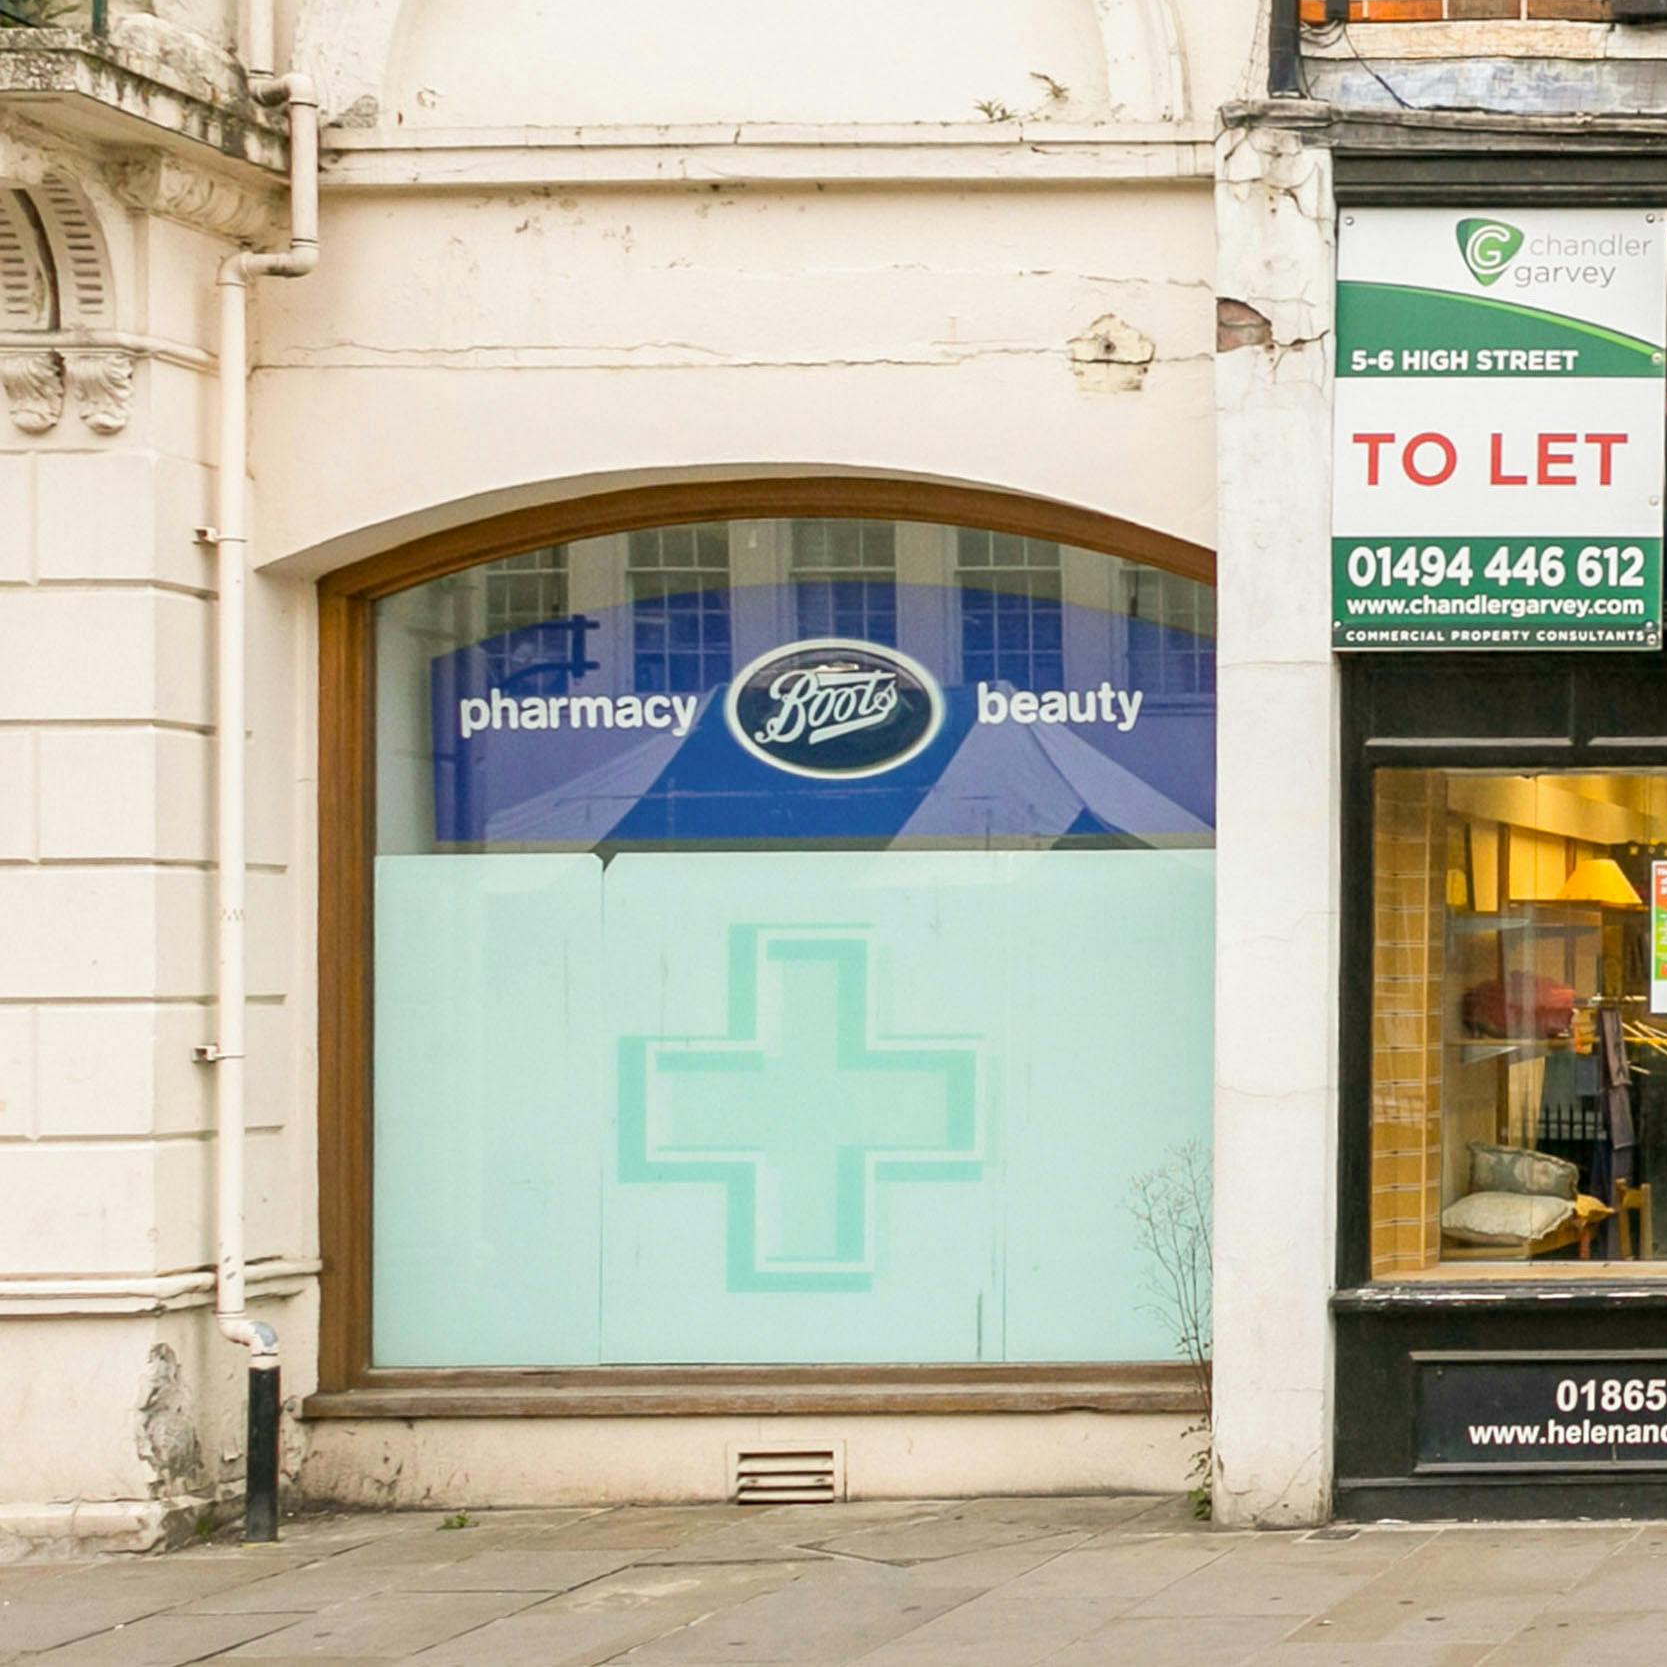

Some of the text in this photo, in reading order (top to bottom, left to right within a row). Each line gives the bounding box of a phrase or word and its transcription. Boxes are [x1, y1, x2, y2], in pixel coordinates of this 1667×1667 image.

[1530, 233, 1653, 256] chandler
[1515, 266, 1616, 288] garvey
[1352, 350, 1578, 371] 5-6 HIGH STREET
[1353, 432, 1628, 486] TO LET
[1349, 547, 1643, 586] 01494 446 612
[1346, 594, 1645, 615] www.chandlergarvey.com
[1345, 629, 1645, 642] COMMERCIAL PROPERTY CONSULTANTS
[461, 690, 697, 738] pharmacy
[754, 664, 899, 746] Boots
[978, 682, 1143, 731] beauty
[1557, 1380, 1666, 1411] 01865
